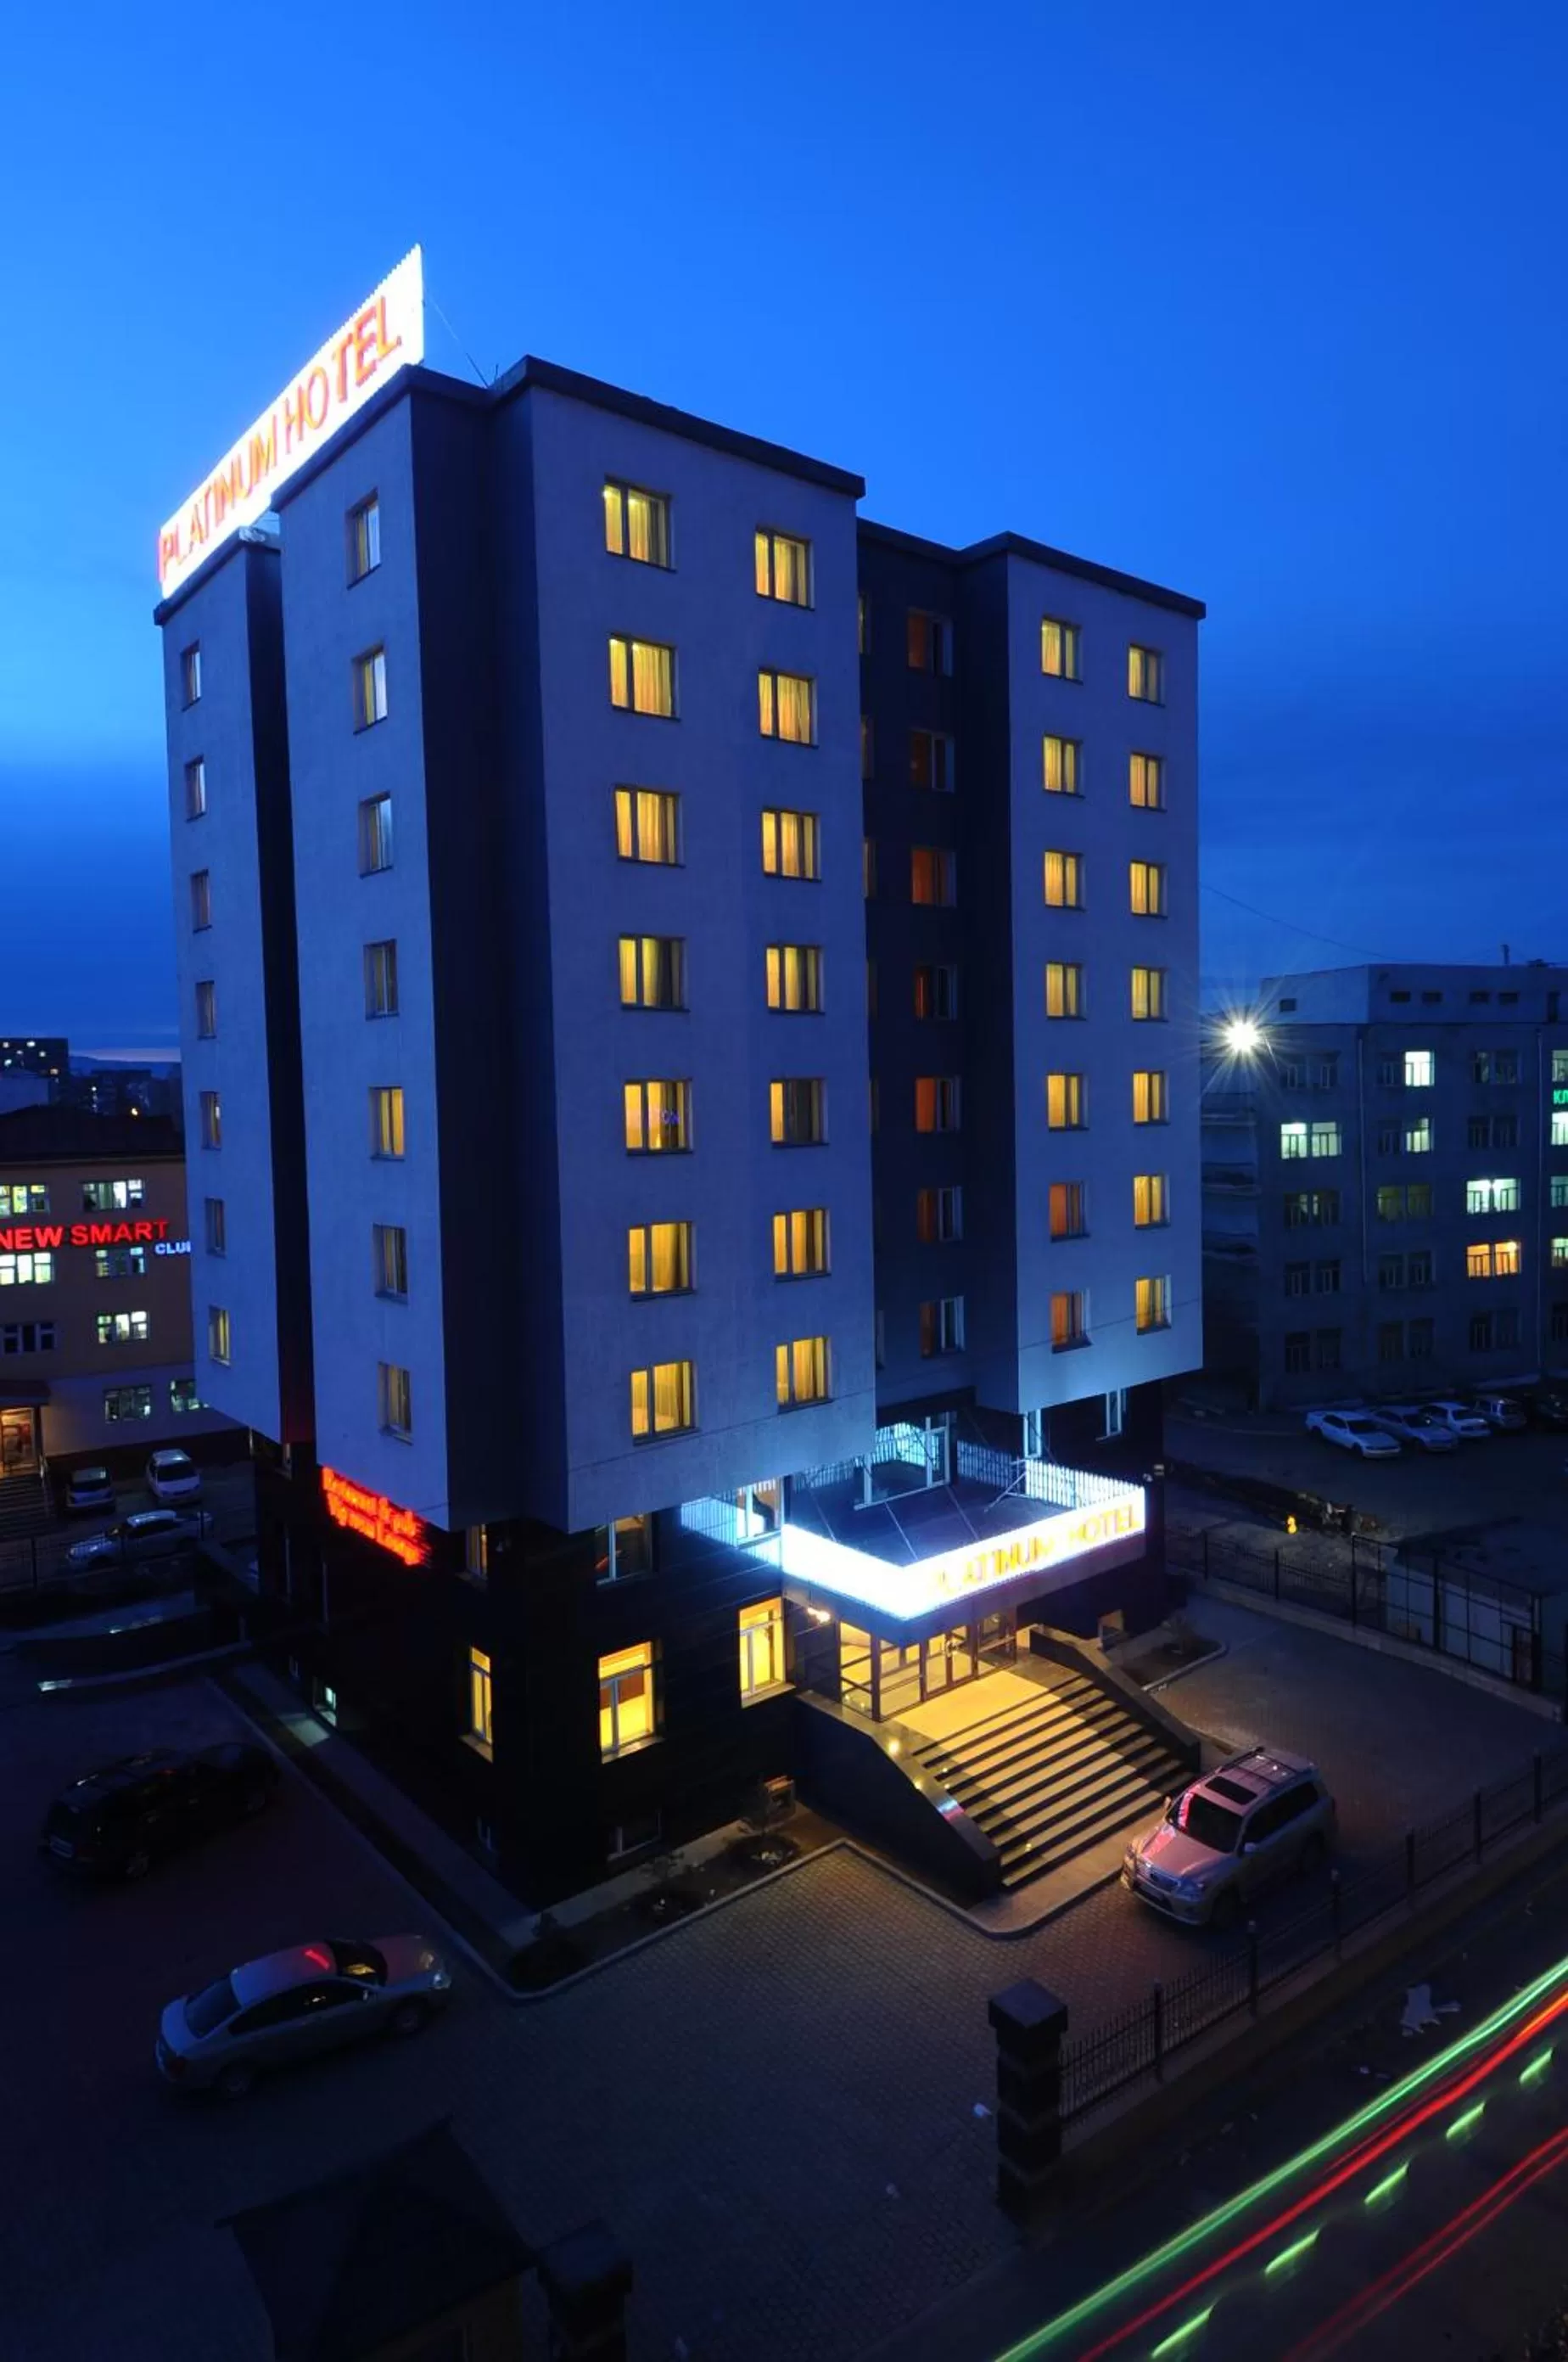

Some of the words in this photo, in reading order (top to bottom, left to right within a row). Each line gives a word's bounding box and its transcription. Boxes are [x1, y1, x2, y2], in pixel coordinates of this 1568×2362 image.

[160, 412, 278, 581] PLATINUM
[285, 295, 402, 454] HOTEL
[0, 1226, 63, 1250] NEW
[70, 1220, 168, 1246] SMART
